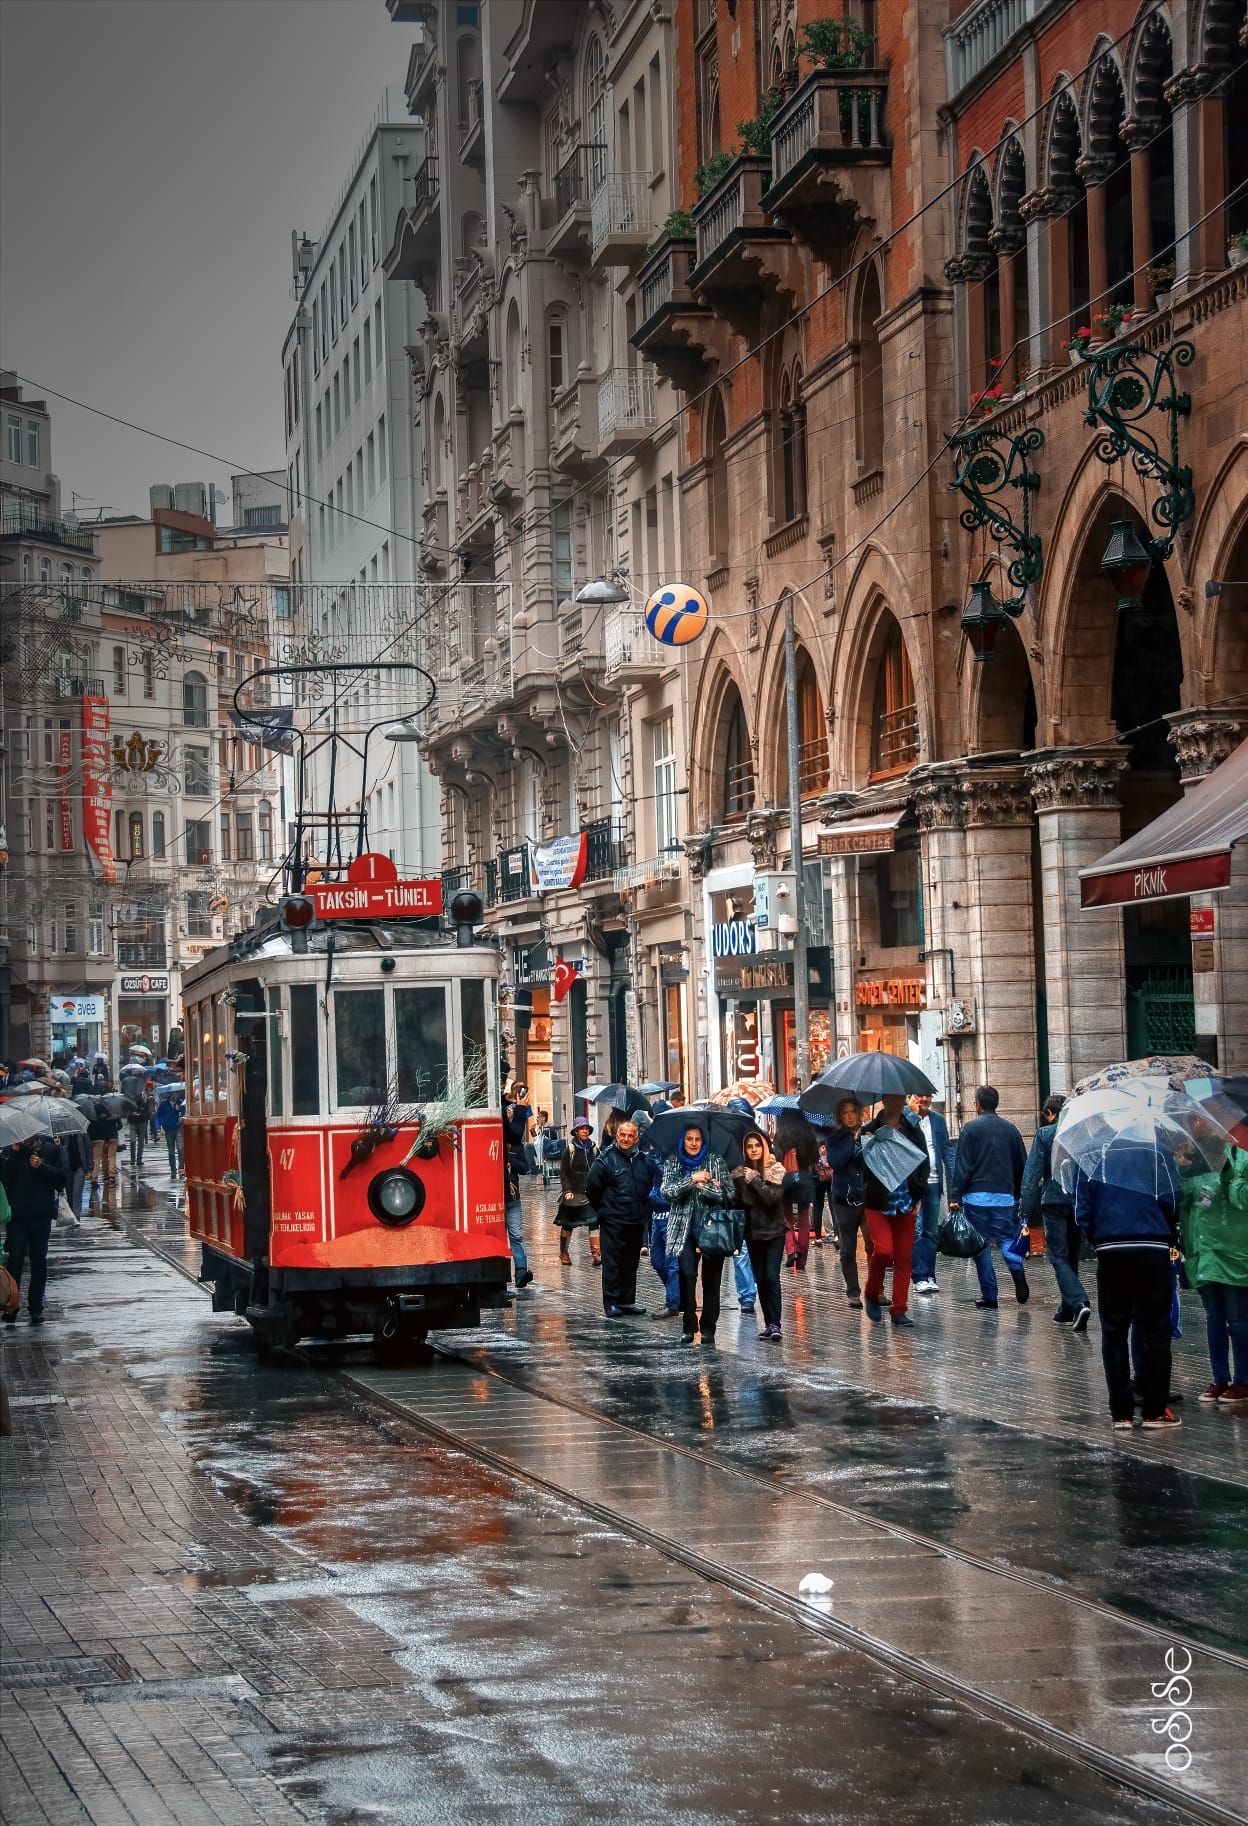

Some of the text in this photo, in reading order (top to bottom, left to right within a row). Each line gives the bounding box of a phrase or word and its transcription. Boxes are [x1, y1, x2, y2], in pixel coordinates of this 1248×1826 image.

[134, 824, 142, 855] HOTEL
[369, 856, 375, 879] 1
[318, 888, 368, 909] TAKSİM
[711, 918, 752, 957] TUDORS
[124, 977, 167, 989] ÖZSÜT CAFE
[77, 1002, 97, 1015] avea
[279, 1148, 295, 1170] 47
[489, 1140, 499, 1160] 47
[294, 1211, 315, 1220] YASAK
